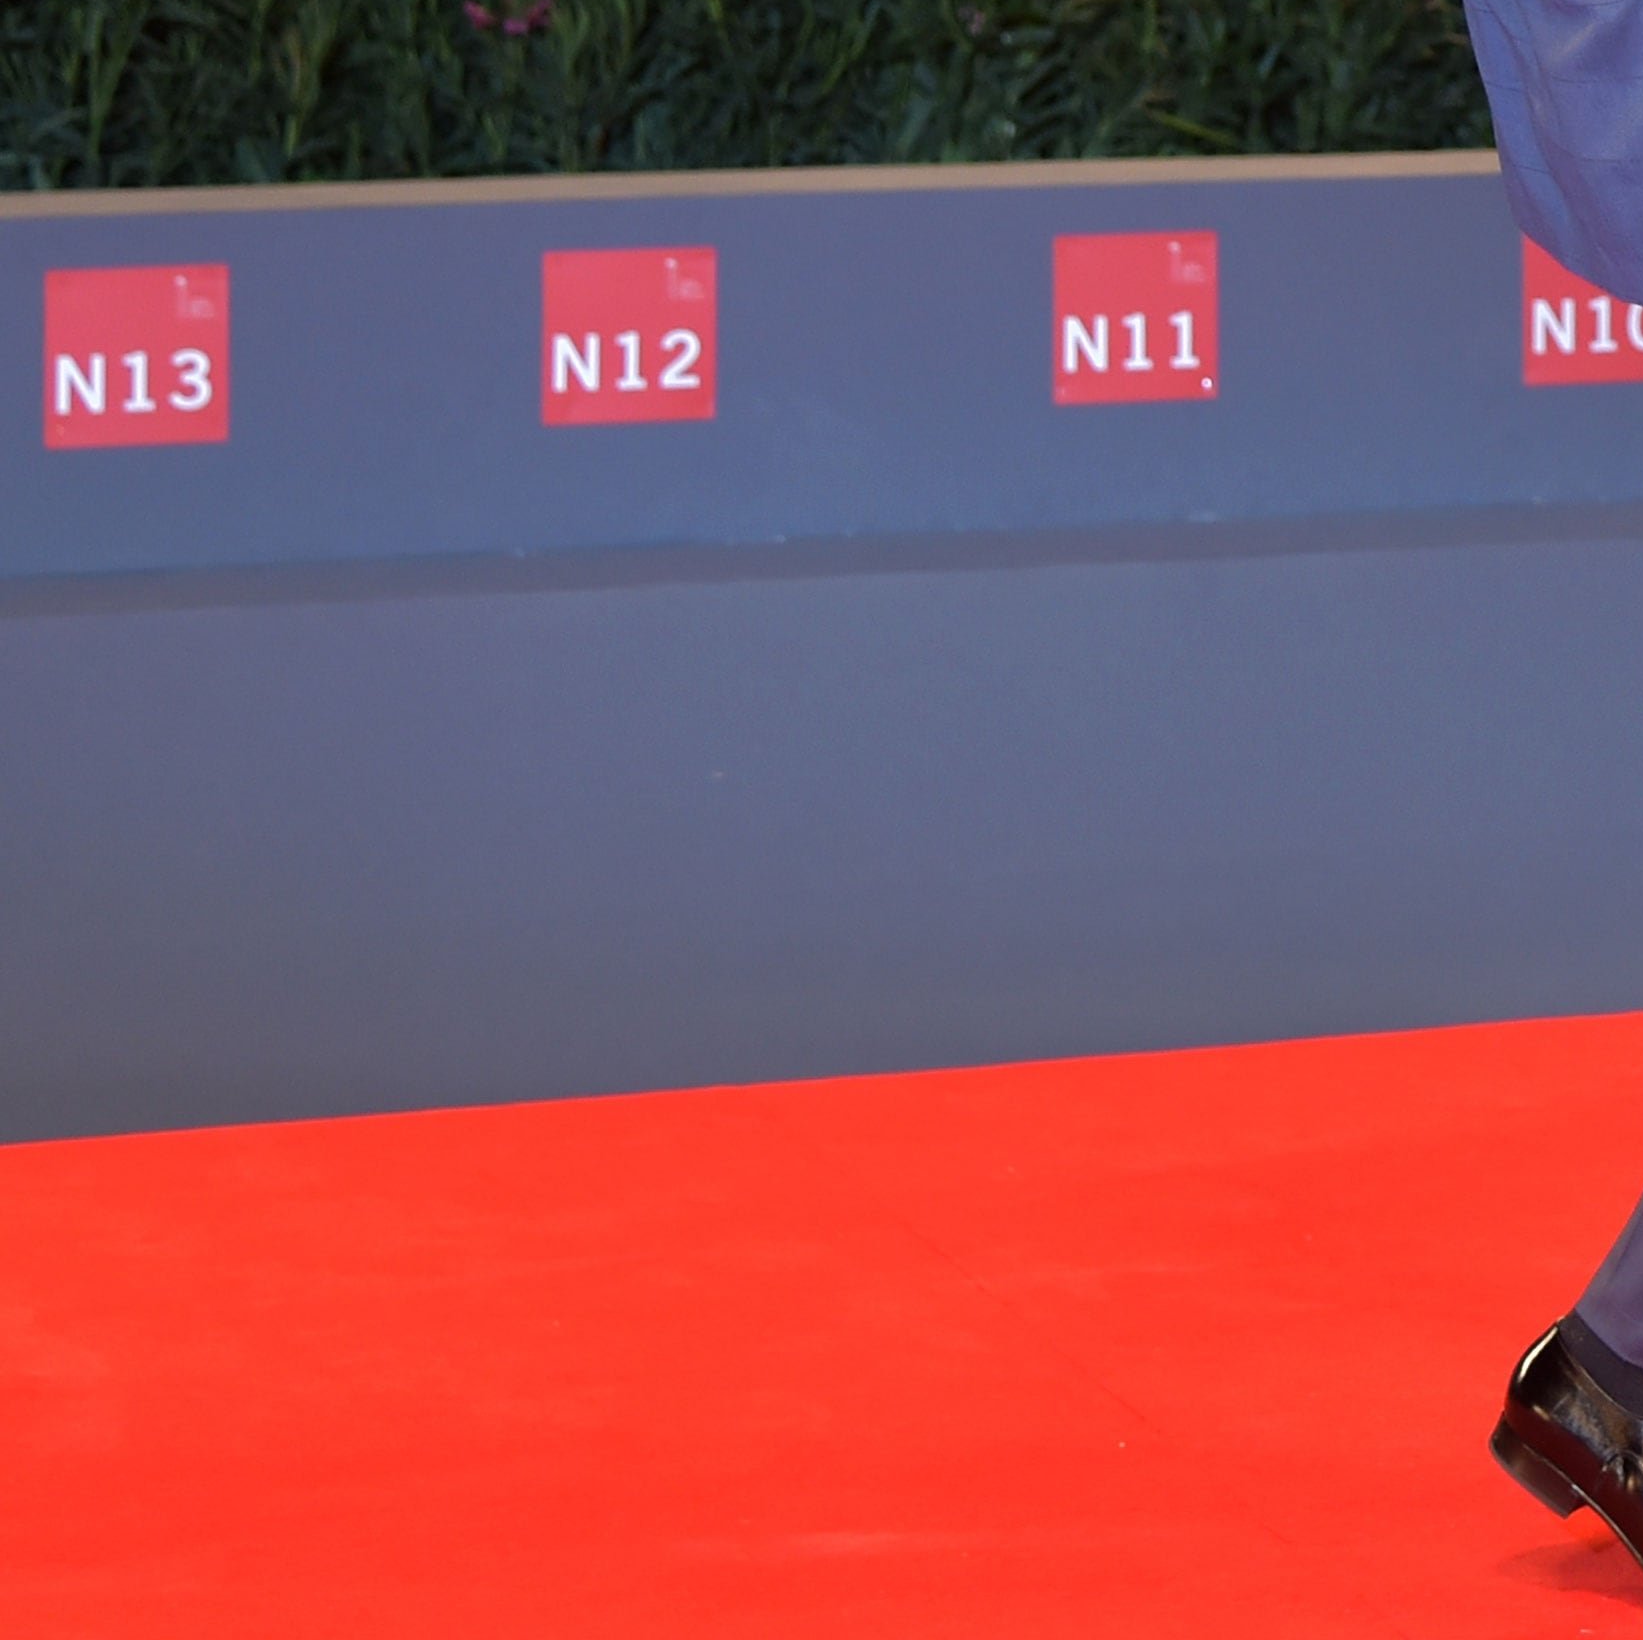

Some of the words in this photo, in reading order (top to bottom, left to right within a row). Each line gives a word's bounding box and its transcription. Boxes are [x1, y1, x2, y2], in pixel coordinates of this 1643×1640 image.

[552, 328, 702, 394] N12
[1063, 311, 1200, 373] N11
[55, 348, 213, 416] N13
